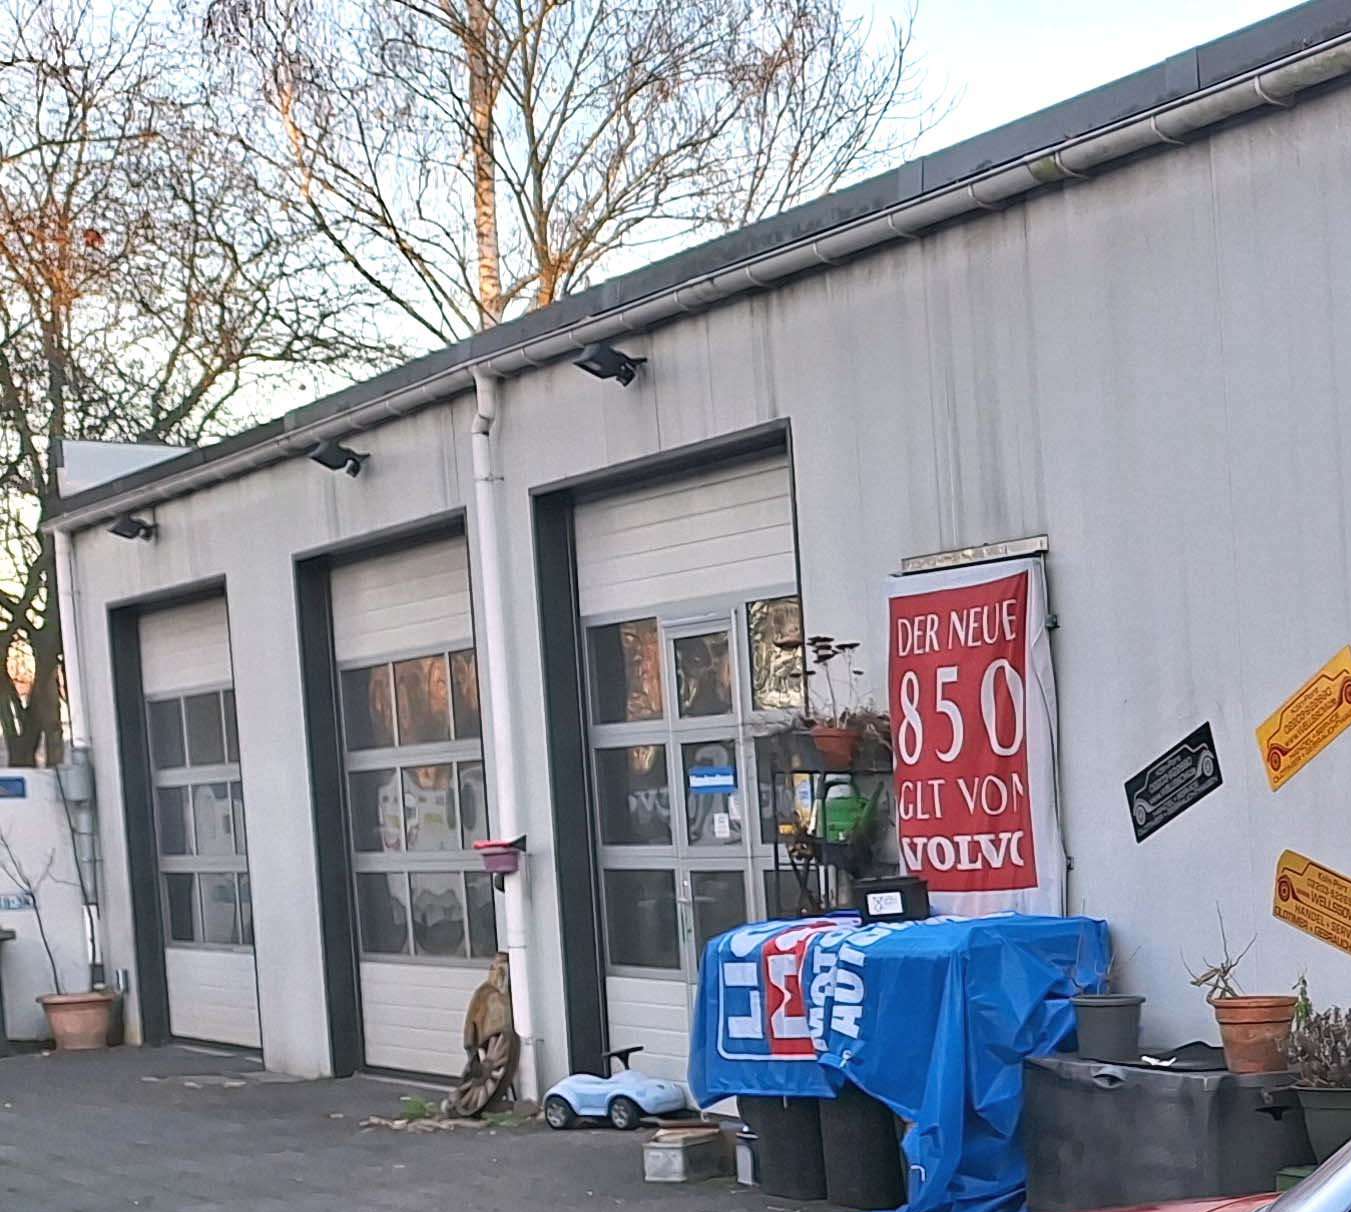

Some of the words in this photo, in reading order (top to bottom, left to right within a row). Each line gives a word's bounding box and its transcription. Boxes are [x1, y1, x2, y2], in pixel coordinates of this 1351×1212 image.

[898, 614, 940, 656] DER
[948, 599, 1017, 650] NEUE
[899, 658, 1024, 766] 850
[899, 780, 946, 820] GLT
